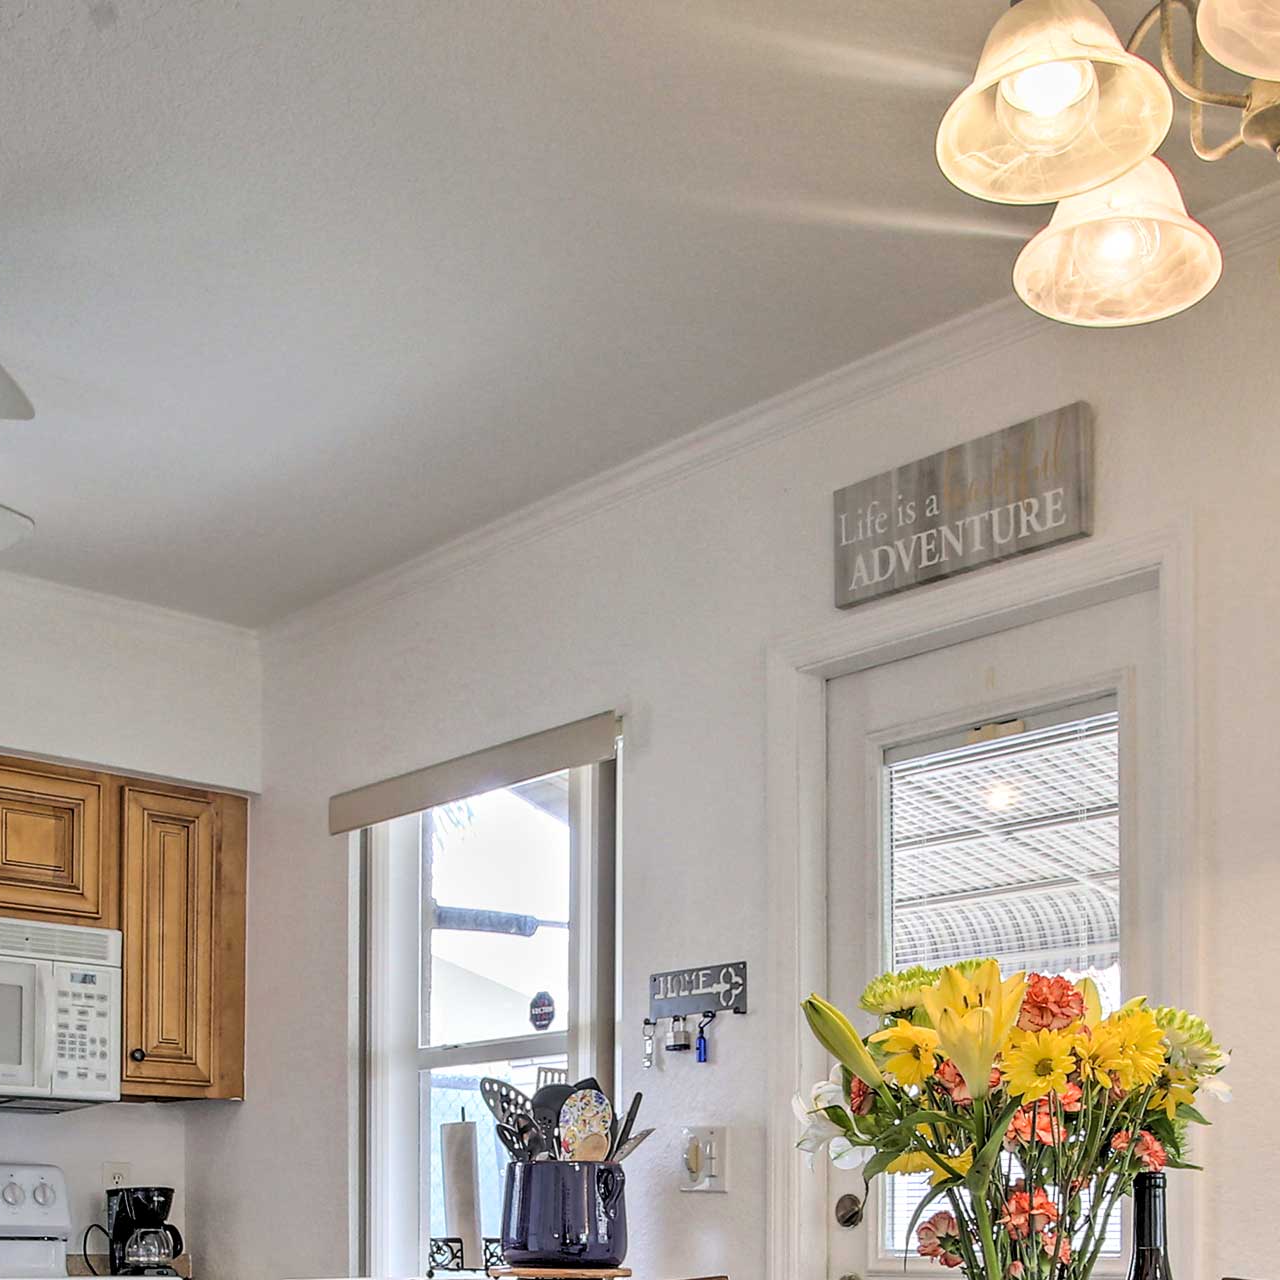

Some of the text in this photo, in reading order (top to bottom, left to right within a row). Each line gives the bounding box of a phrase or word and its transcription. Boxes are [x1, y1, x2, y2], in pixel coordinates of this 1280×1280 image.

[840, 500, 888, 546] Life
[896, 491, 916, 526] is
[925, 494, 940, 517] a
[849, 488, 1066, 590] ADVENTURE
[655, 969, 713, 1000] HOME
